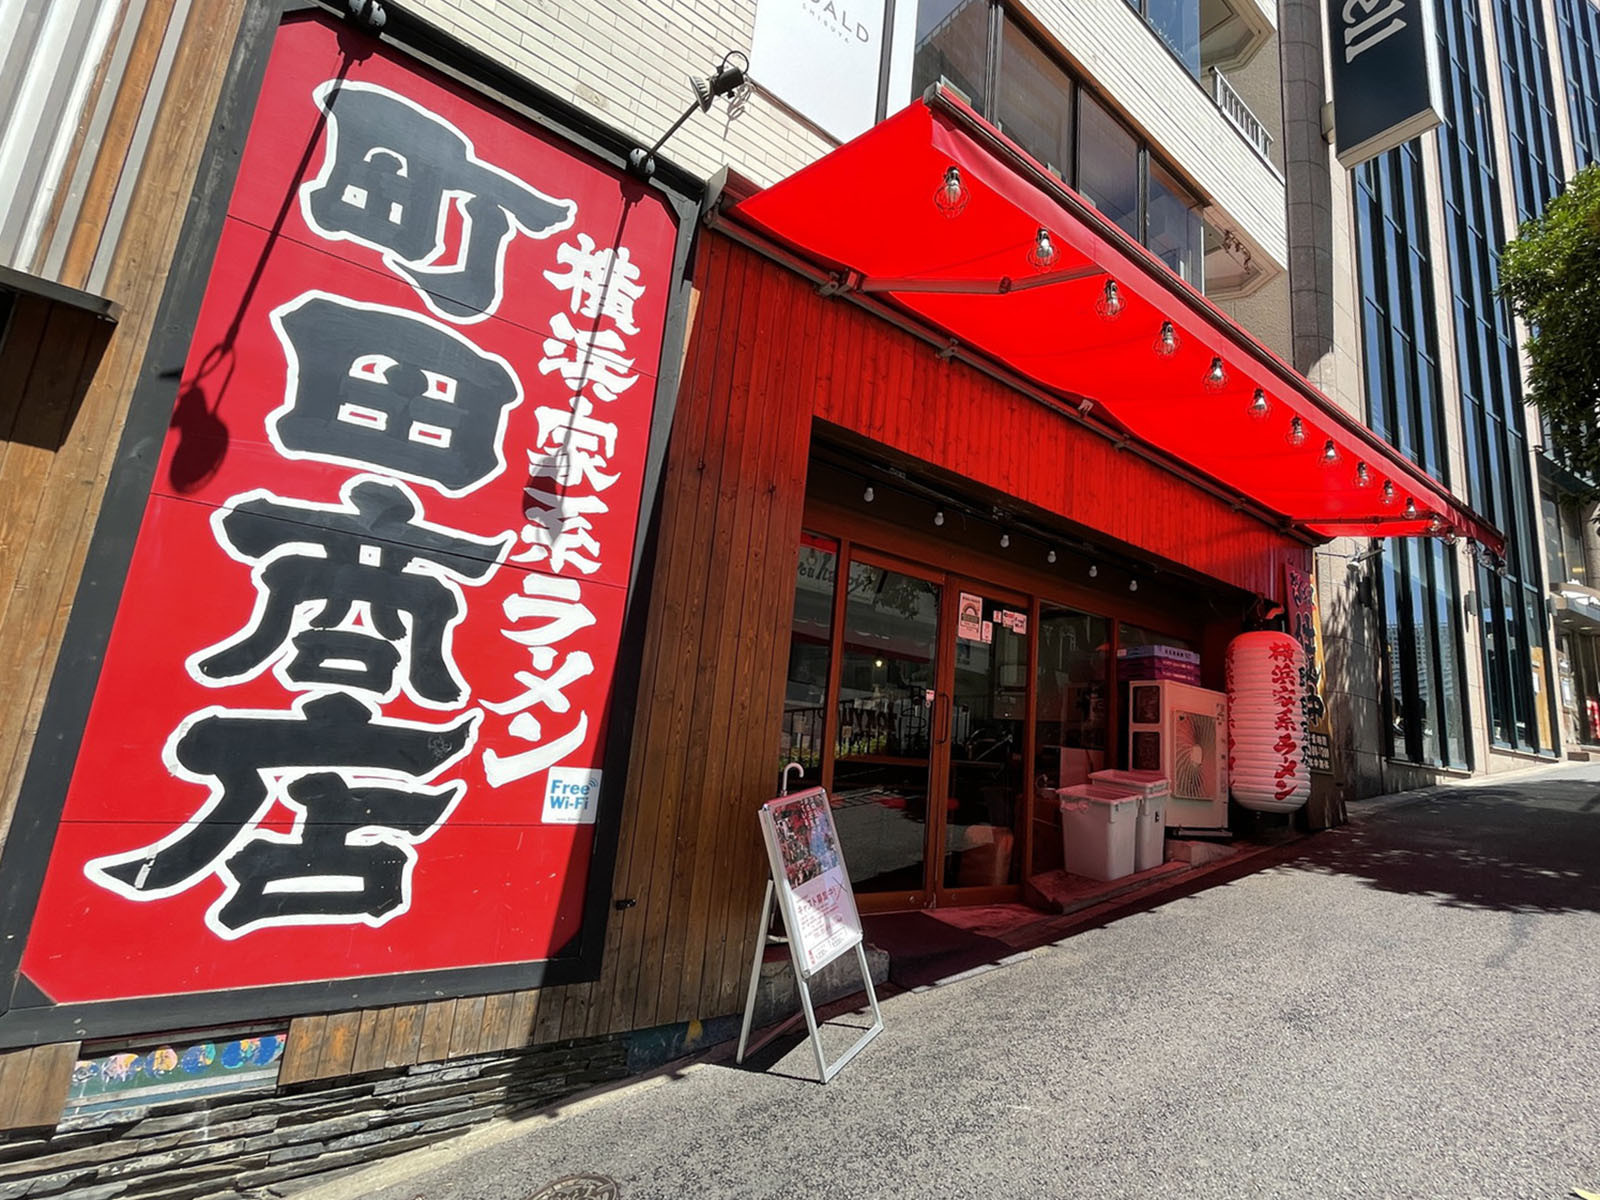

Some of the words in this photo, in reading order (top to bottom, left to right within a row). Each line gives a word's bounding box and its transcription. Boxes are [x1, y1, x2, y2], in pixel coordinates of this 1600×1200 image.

[811, 0, 869, 43] ALD
[84, 78, 578, 941] 町田商店
[479, 232, 645, 788] 横浜家系ラーメン
[550, 779, 590, 795] Free
[550, 795, 589, 810] Wi-Fi
